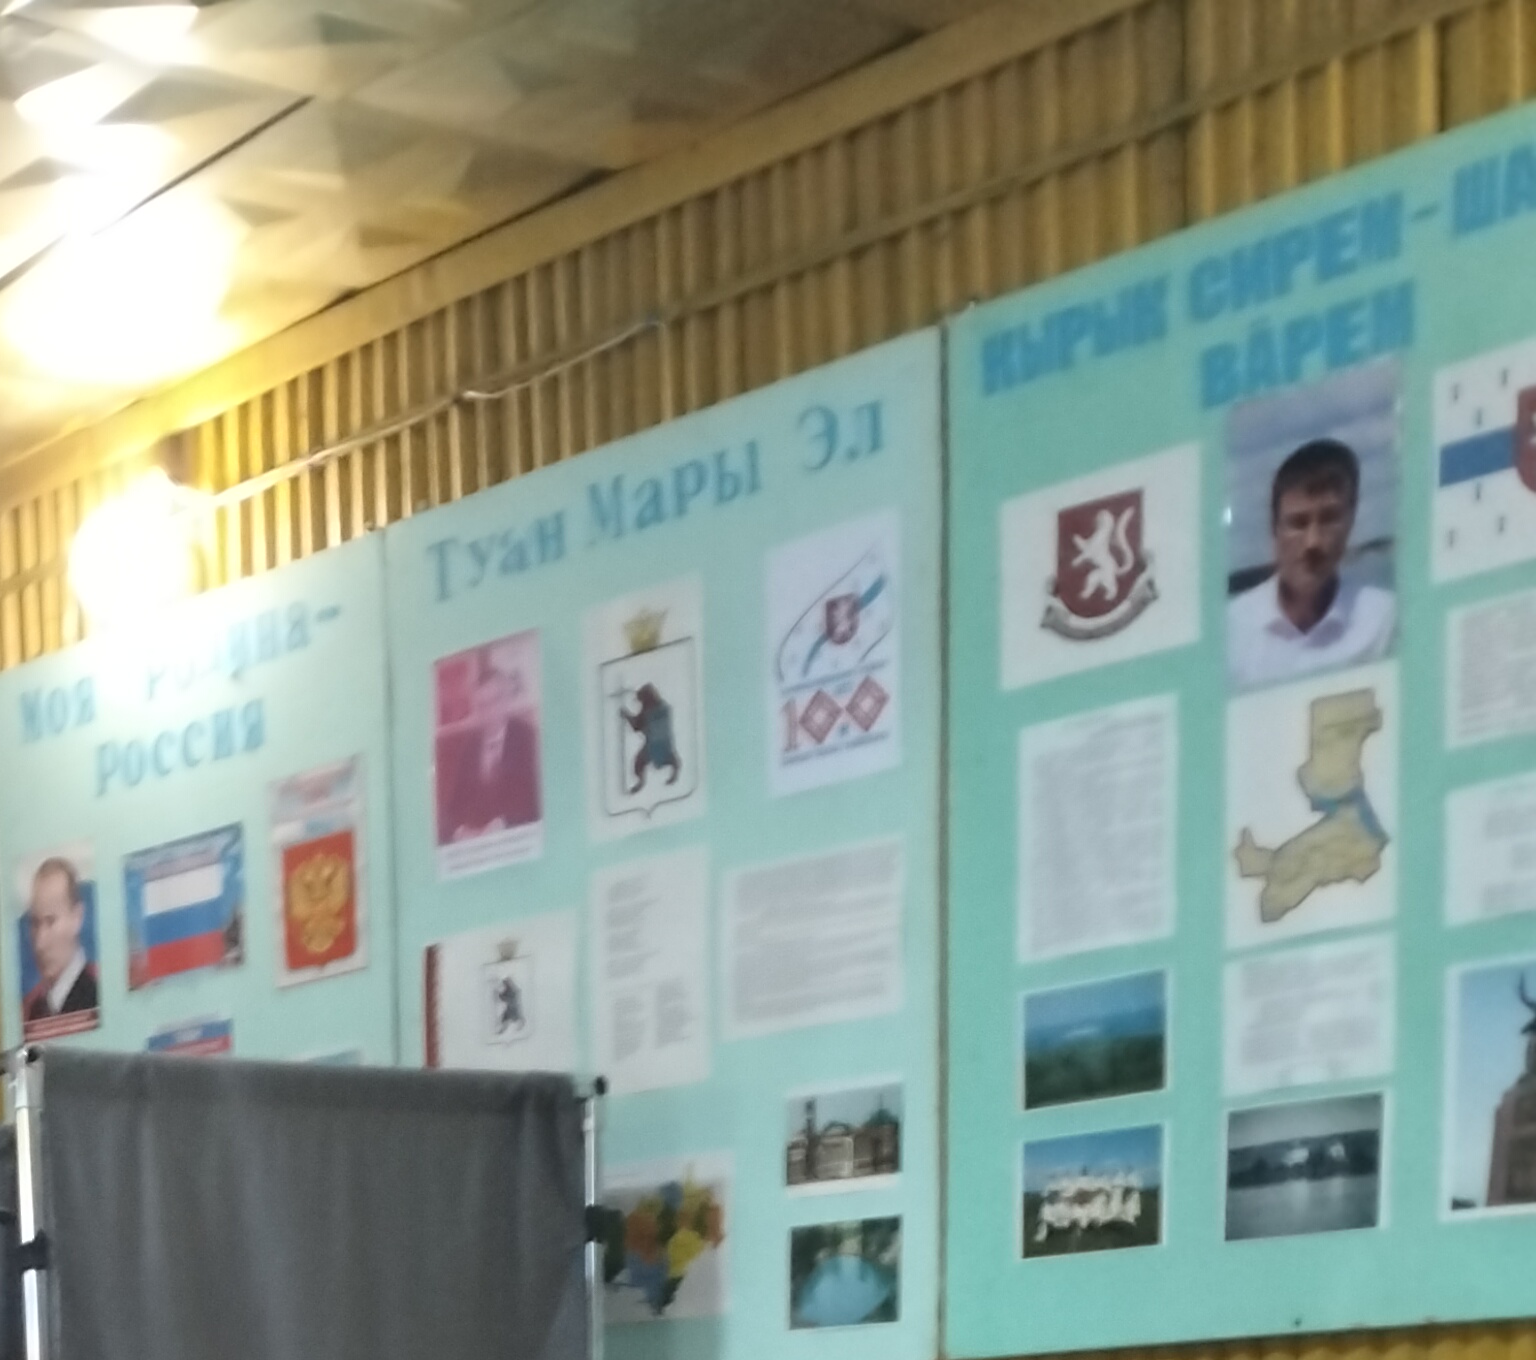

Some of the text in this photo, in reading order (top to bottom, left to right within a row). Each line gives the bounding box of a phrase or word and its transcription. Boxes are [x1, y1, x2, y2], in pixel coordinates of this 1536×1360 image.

[426, 399, 887, 602] Туан Мары Эл
